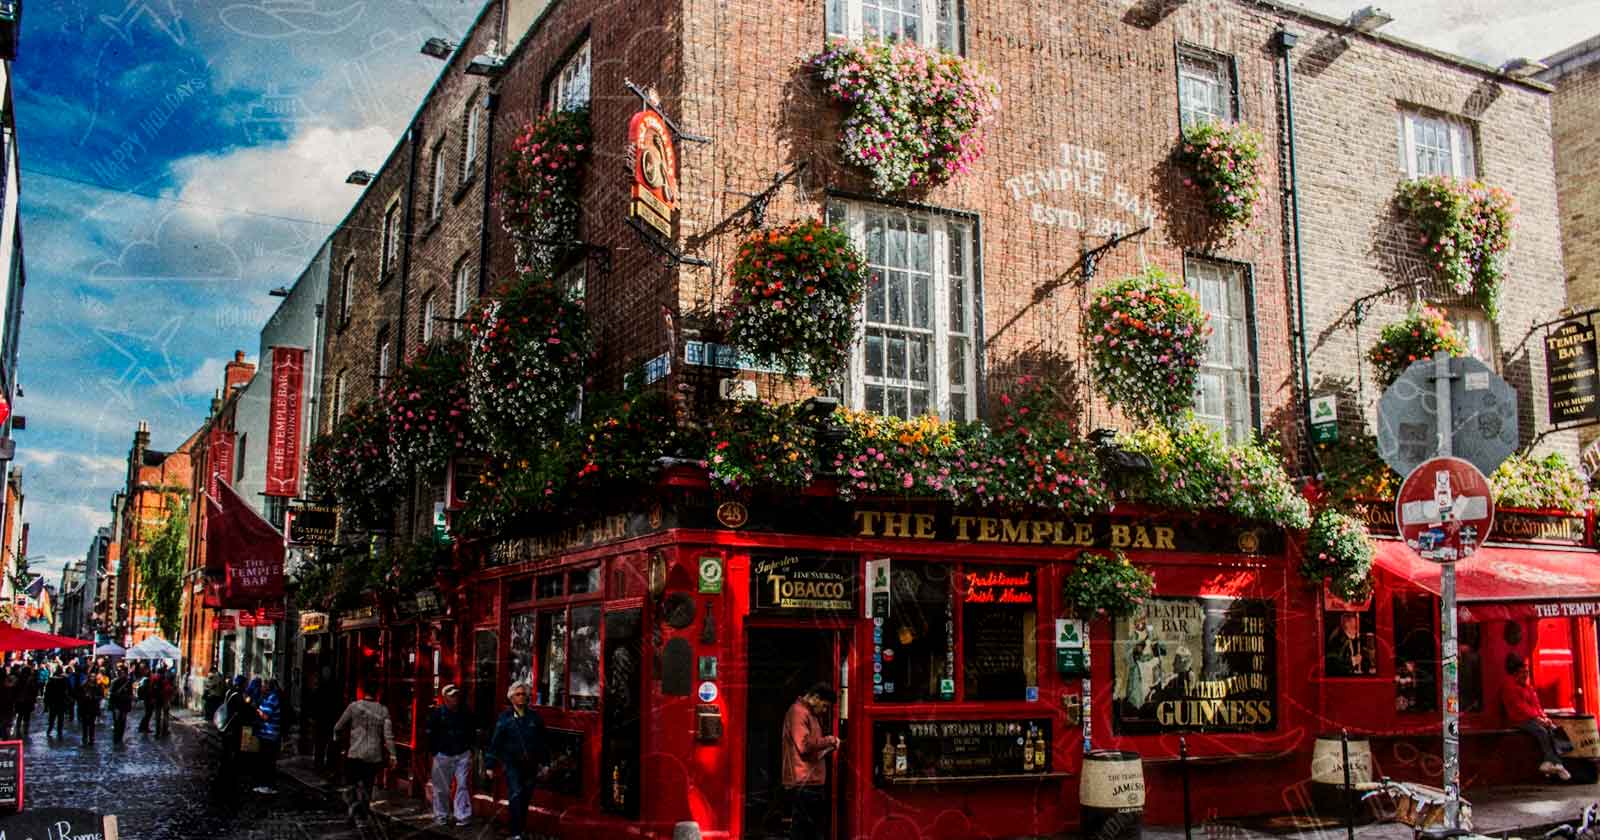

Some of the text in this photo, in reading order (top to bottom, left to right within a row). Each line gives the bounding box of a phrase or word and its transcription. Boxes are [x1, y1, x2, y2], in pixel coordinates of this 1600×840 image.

[1059, 143, 1106, 171] THE
[1005, 168, 1104, 202] TEMPLE
[1561, 325, 1578, 336] THE
[1547, 331, 1594, 350] TEMPLE
[1559, 346, 1584, 360] BAR
[1567, 368, 1597, 381] GARDEN
[1553, 395, 1596, 408] LIVE MUSIC
[1563, 405, 1586, 416] DAILY
[274, 375, 288, 473] THE TEMPLE BAR
[287, 408, 297, 456] TRADING
[722, 502, 741, 520] 48
[591, 511, 625, 544] BAR
[854, 511, 1177, 550] THE TEMPLE BAR
[230, 566, 279, 577] TEMPLE
[755, 555, 799, 574] Importers
[242, 577, 268, 587] BAR
[966, 572, 1030, 586] Traditional
[767, 574, 844, 604] TOBACCO
[965, 588, 1033, 603] Irish Music
[1535, 603, 1560, 617] THE
[1161, 619, 1189, 634] BAR
[1243, 617, 1265, 634] THE
[1215, 634, 1265, 653] EMPEROR
[1252, 656, 1265, 672] OF
[1183, 679, 1227, 699] MALTED
[1156, 700, 1272, 727] GUINNESS
